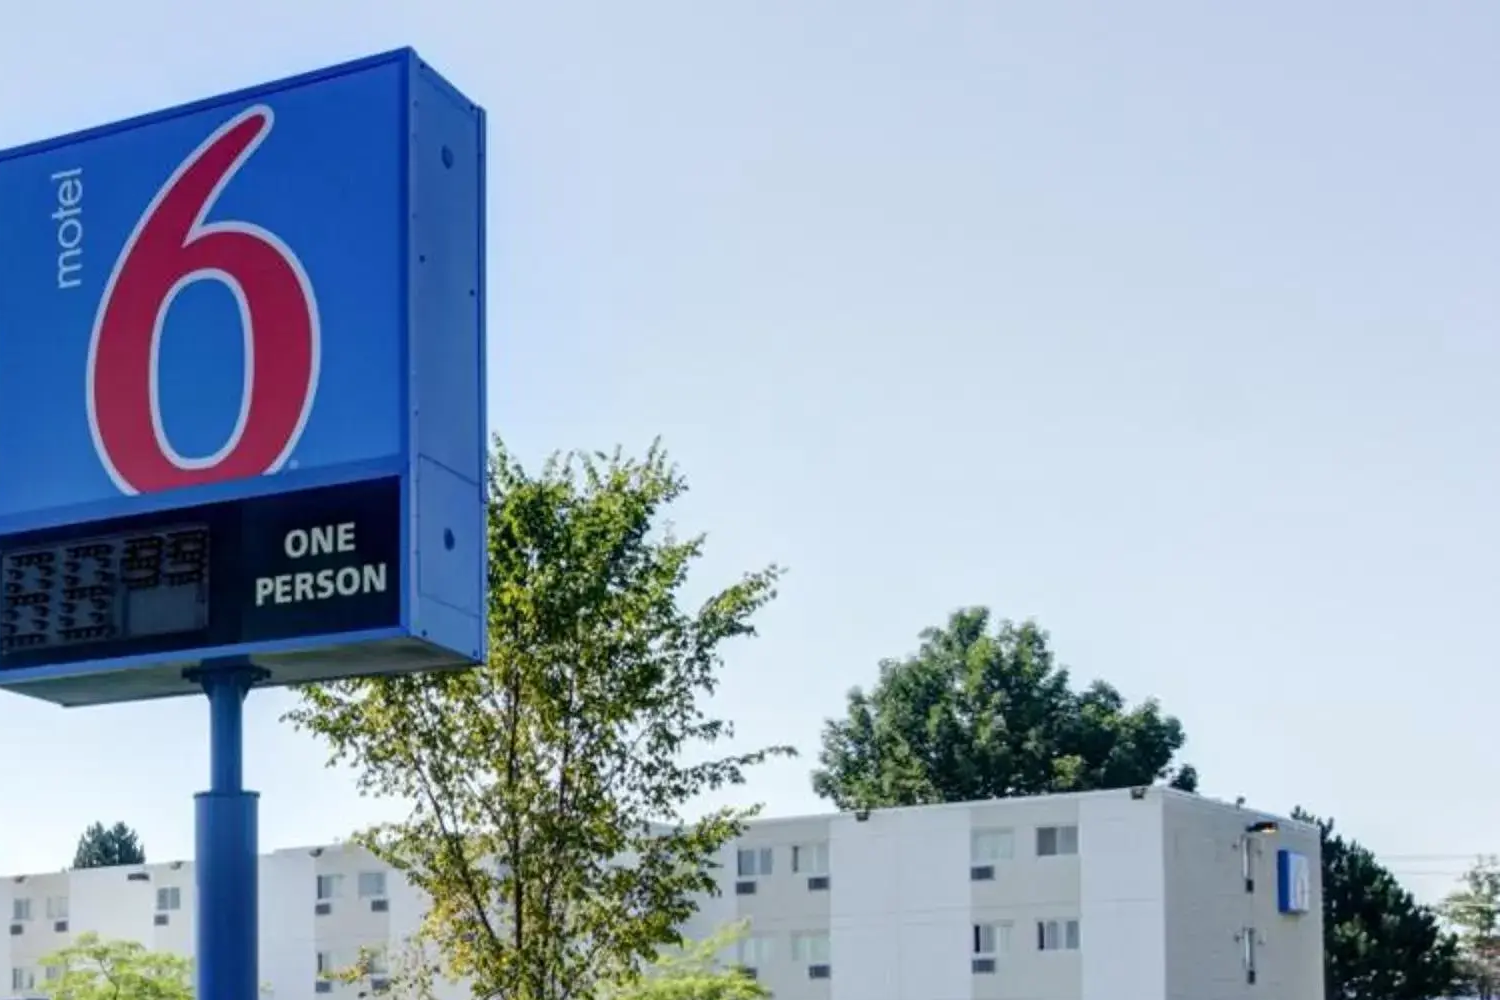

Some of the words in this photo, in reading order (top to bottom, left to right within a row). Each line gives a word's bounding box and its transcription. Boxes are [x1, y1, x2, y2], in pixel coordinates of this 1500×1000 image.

[51, 167, 83, 288] motel
[86, 104, 320, 496] 6
[284, 521, 356, 559] ONE
[255, 562, 387, 607] PERSON
